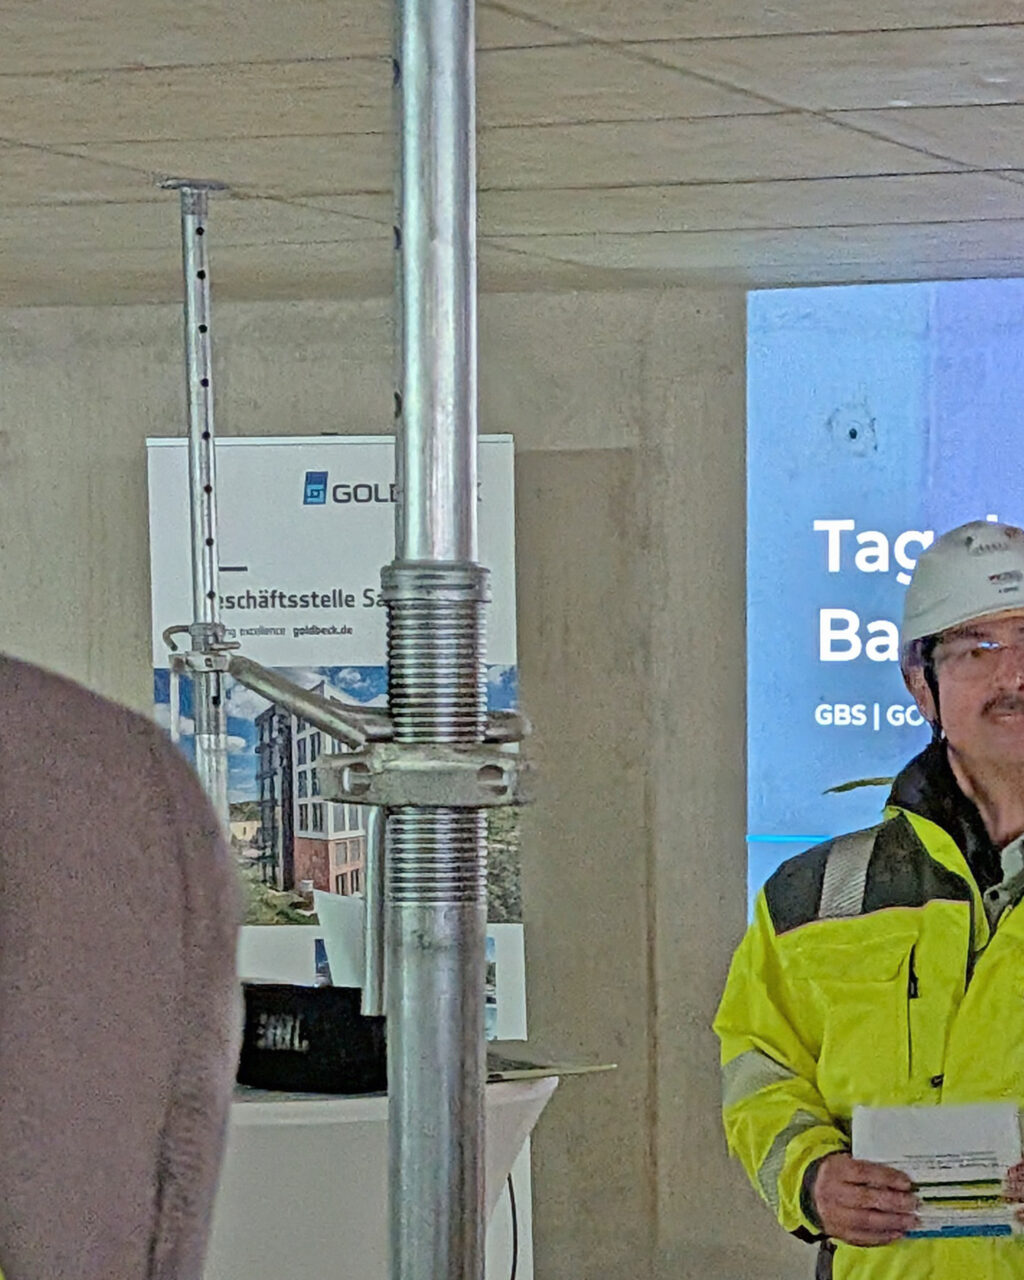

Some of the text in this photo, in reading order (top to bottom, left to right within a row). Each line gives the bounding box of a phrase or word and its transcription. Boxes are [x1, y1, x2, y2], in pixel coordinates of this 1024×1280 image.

[813, 519, 935, 586] Tag
[293, 624, 353, 638] goldbeck.de
[819, 608, 899, 662] Ba
[815, 703, 867, 726] GBS
